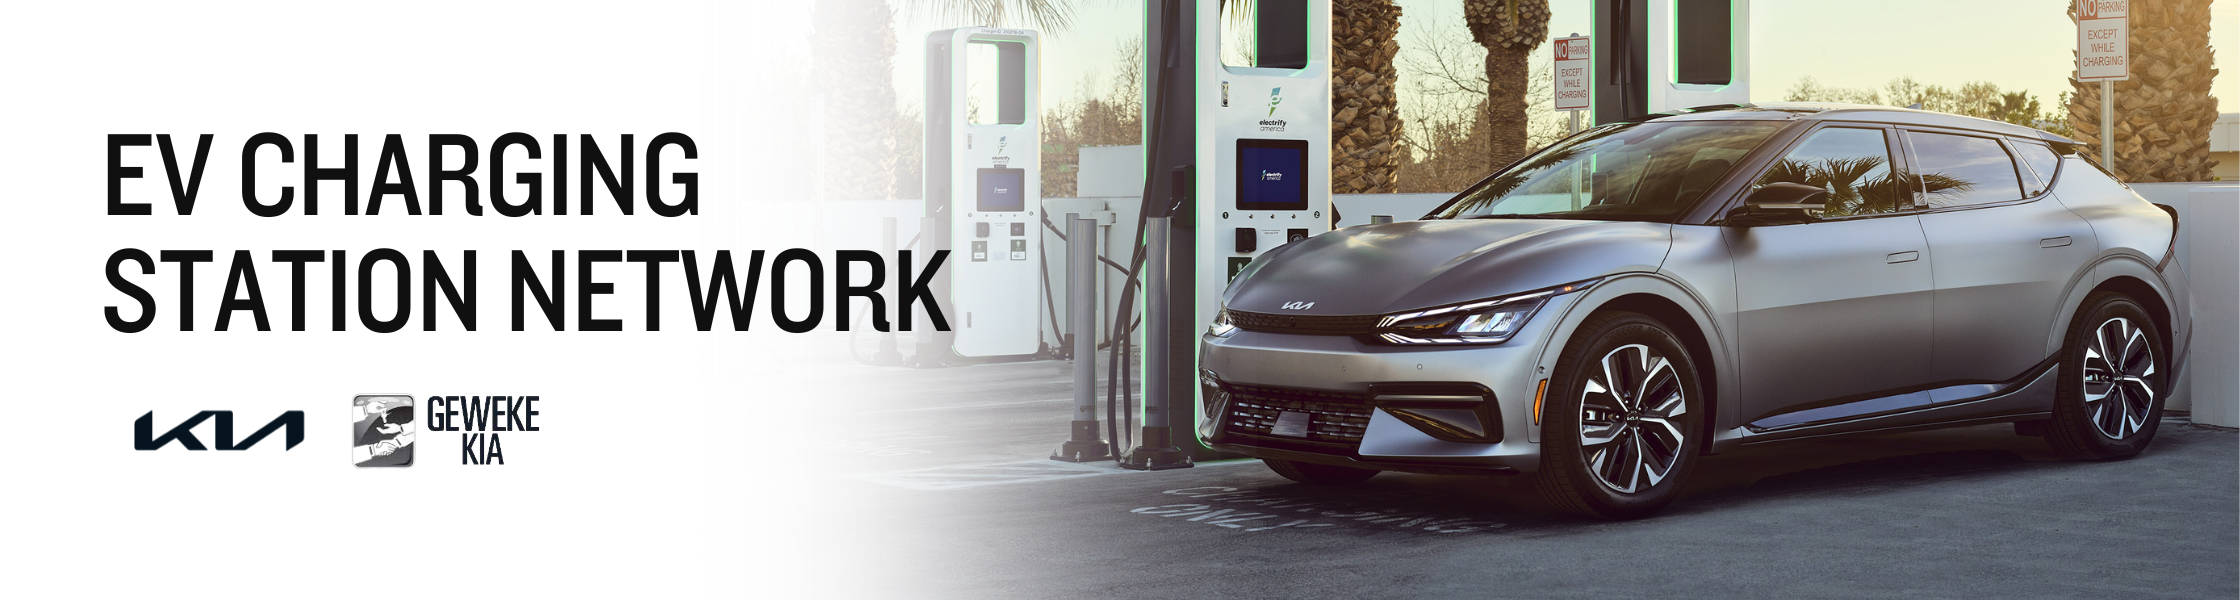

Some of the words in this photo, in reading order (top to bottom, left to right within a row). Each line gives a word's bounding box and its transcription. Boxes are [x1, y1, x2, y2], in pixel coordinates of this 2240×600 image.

[2080, 0, 2096, 16] NO
[2098, 1, 2125, 13] PARKING
[2088, 29, 2118, 39] EXCEPT
[1555, 43, 1567, 58] NO
[1569, 45, 1588, 55] PARKING
[2091, 42, 2115, 53] WHILE
[2083, 55, 2124, 67] CHARGING
[1561, 68, 1583, 77] EXCEPT
[1563, 79, 1580, 88] WHILE
[1558, 90, 1587, 99] CHARGING
[1259, 119, 1287, 128] electrify
[1281, 300, 1315, 310] KIA
